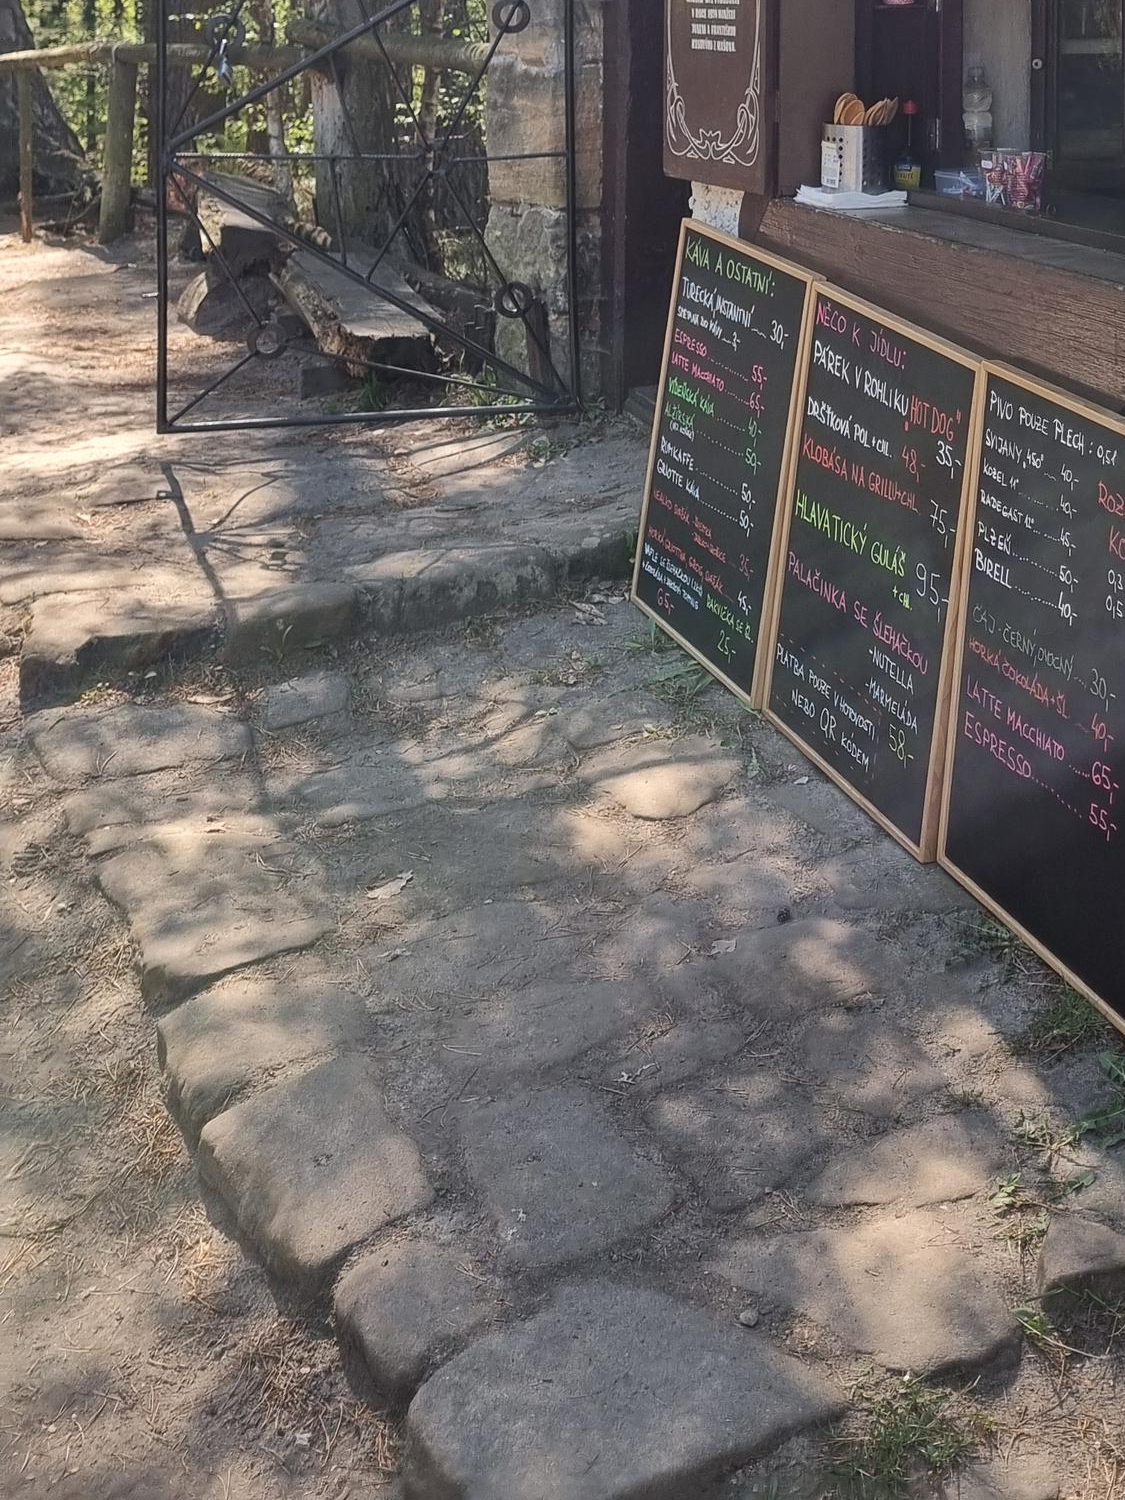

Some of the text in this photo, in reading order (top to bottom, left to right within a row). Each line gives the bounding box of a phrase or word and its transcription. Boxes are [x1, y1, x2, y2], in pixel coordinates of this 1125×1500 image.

[685, 236, 710, 270] KÁVA
[715, 252, 723, 276] A
[674, 328, 707, 357] ESPRESSO
[816, 301, 846, 333] NĚCO
[852, 322, 861, 347] K
[814, 339, 850, 385] PÁREK
[855, 365, 863, 389] V
[989, 390, 1013, 420] PIVO
[1018, 406, 1048, 436] POUZE
[802, 433, 848, 482] KLOBÁSA
[852, 463, 865, 488] NA
[983, 457, 1007, 487] KOZEL
[980, 489, 1023, 524] RADEGAST
[795, 490, 906, 577] HLAVATICKÝ GULÁŠ
[978, 521, 1011, 555] PLZEŇ
[974, 548, 1012, 589] BIRELL
[1108, 569, 1123, 592] 0,3
[789, 551, 928, 675] PALAČINKA SE ŠLEHAČKOU
[1105, 595, 1123, 619] 0,5
[777, 643, 805, 681] PLATBA
[809, 669, 831, 700] POUZE
[969, 636, 1001, 672] HORKÁ
[791, 689, 870, 772] NEBO QR KÓDEM
[966, 674, 1002, 719] LATTE
[1007, 708, 1065, 760] MACCHIATO
[964, 711, 1032, 778] ESPRESSO
